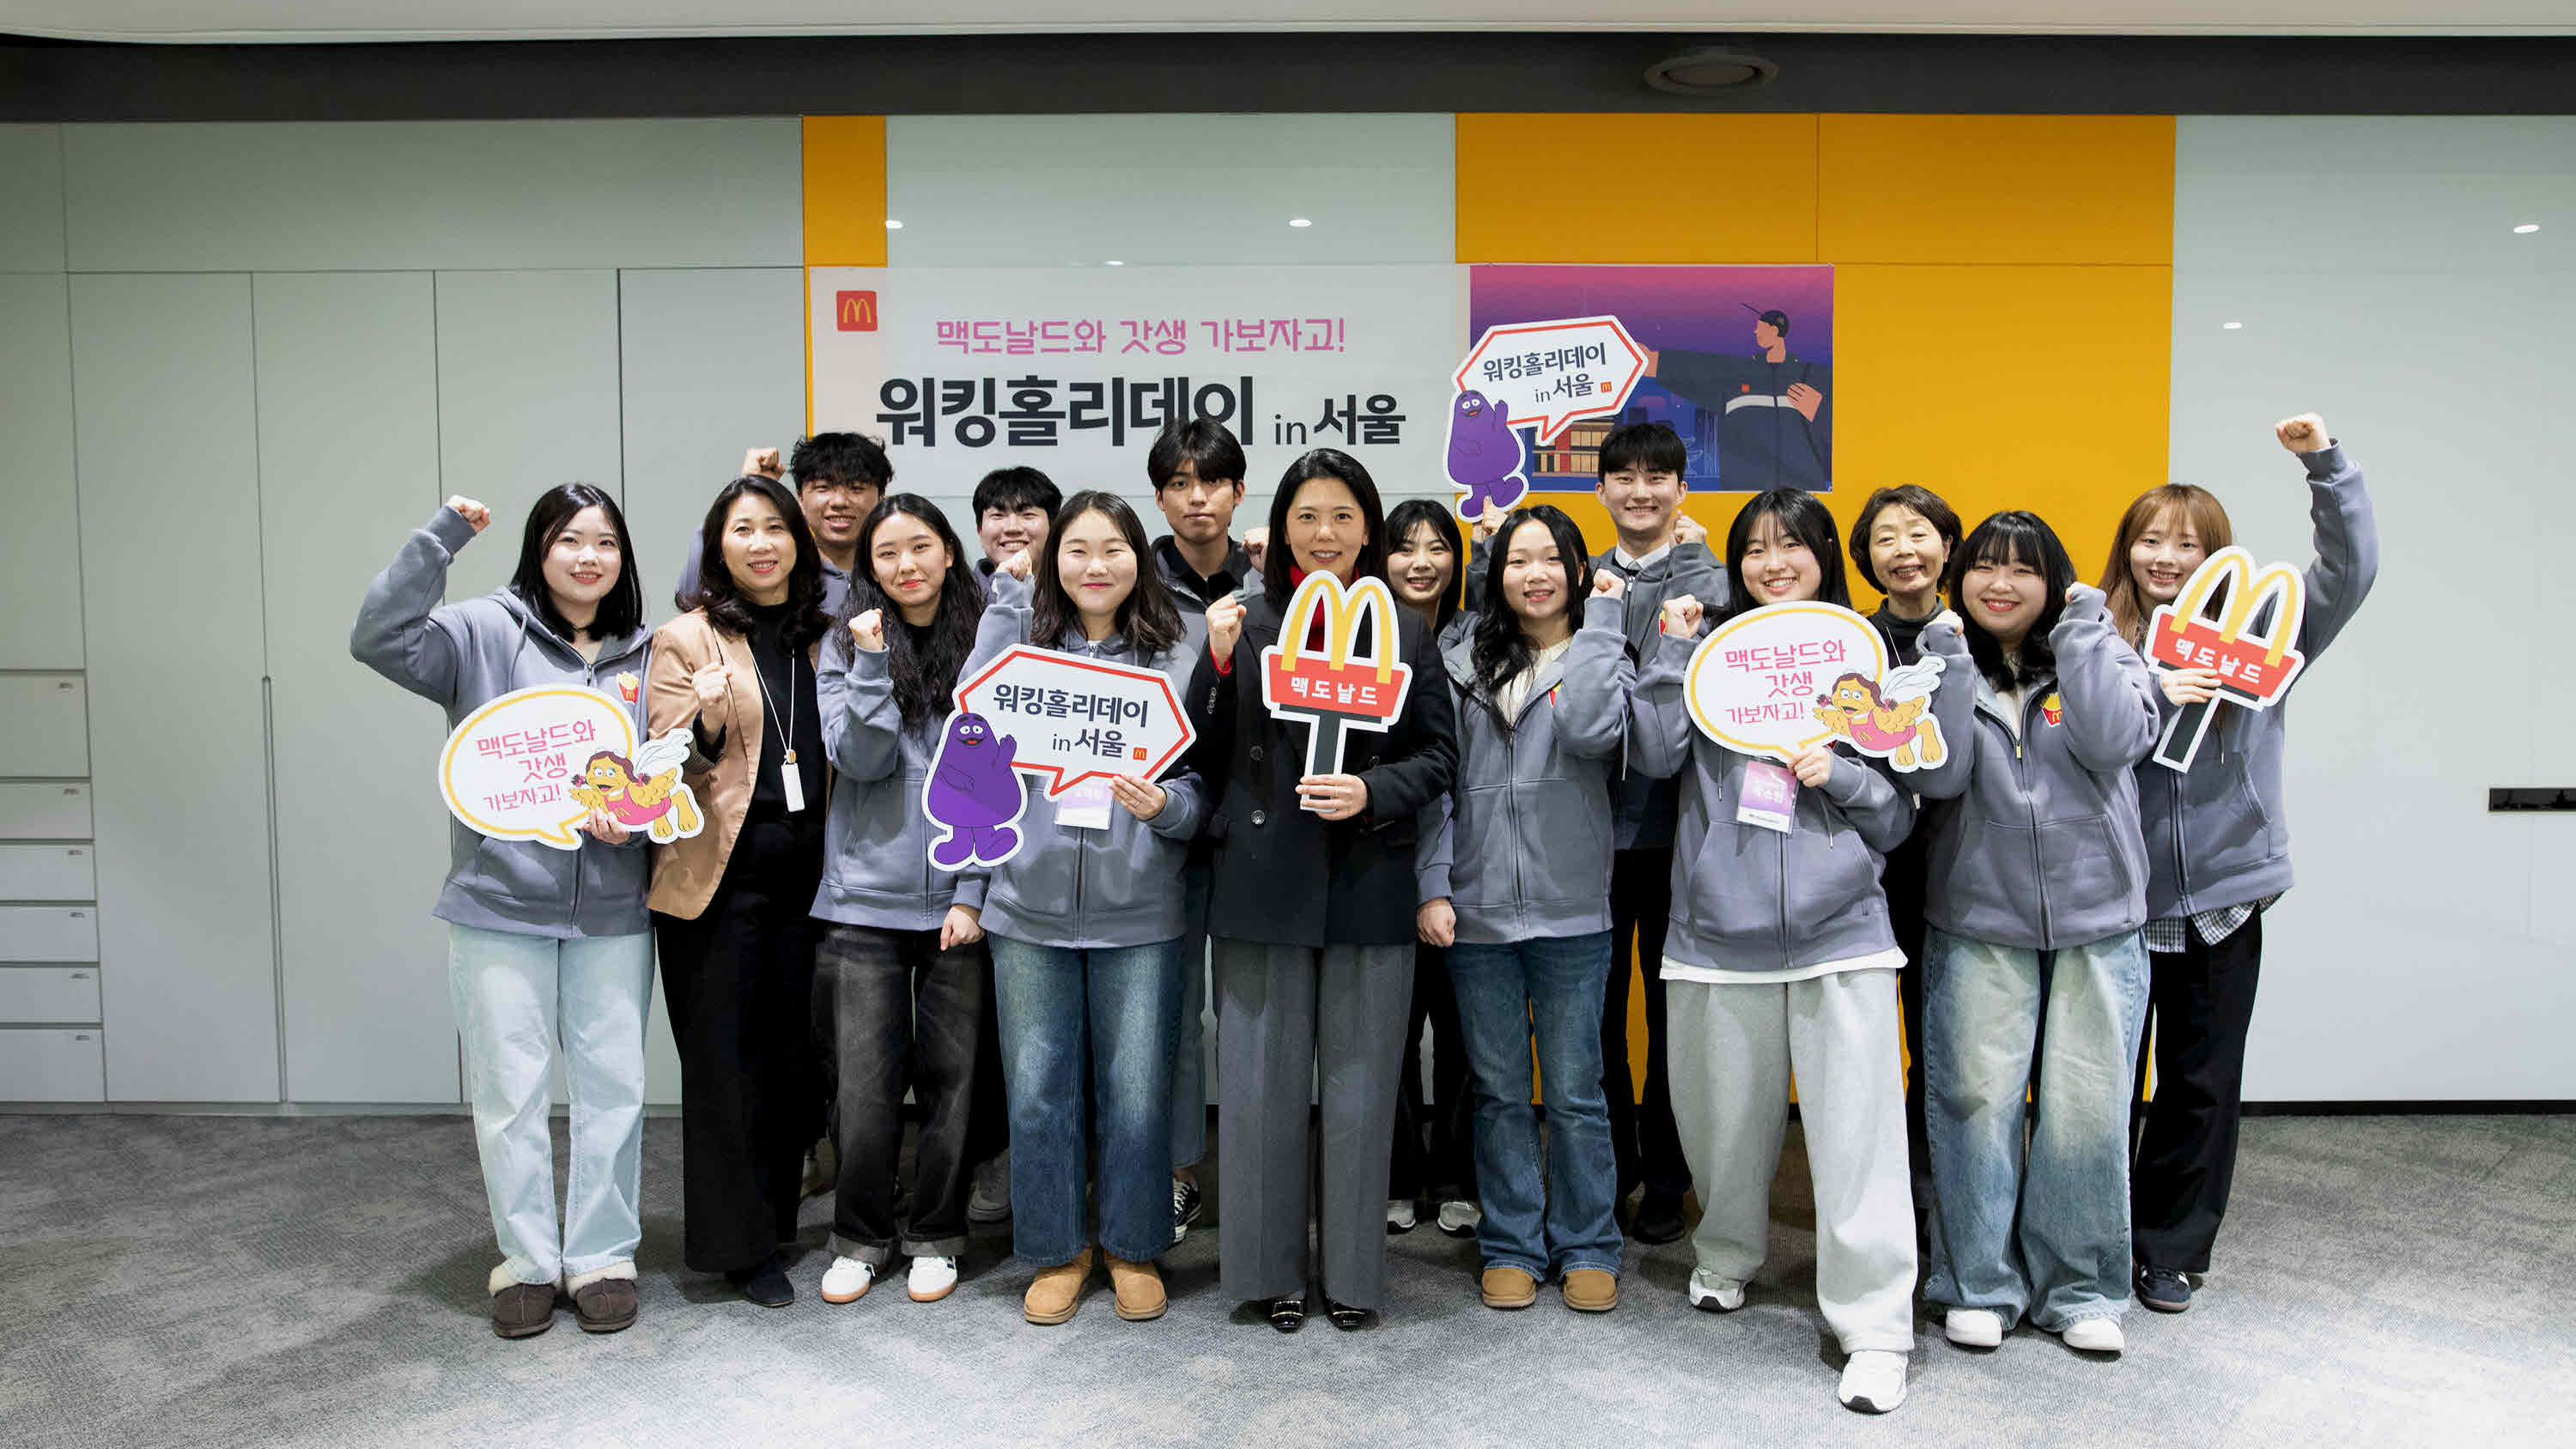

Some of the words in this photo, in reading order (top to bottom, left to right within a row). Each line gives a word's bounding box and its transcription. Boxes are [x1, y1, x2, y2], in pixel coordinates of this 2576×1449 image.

[936, 318, 1107, 355] 맥도날드와
[1120, 318, 1188, 355] 갓생
[1200, 318, 1346, 354] 가보자고!
[1483, 343, 1607, 382] 워킹홀리데이
[1534, 388, 1551, 404] in
[1552, 373, 1595, 398] 서울
[876, 375, 1253, 448] 워킹홀리데이
[1274, 414, 1307, 446] in
[1313, 394, 1407, 446] 서울
[1724, 640, 1847, 673] 맥도날드와
[2175, 637, 2263, 684] 맥도날드
[1291, 676, 1378, 705] 맥도날드
[1765, 670, 1814, 698] 갓생
[993, 683, 1149, 728] 워킹홀리데이
[1725, 702, 1804, 725] 가보자고!
[477, 719, 596, 759] 맥도날드와
[1053, 733, 1071, 752] in
[1075, 728, 1127, 759] 서울
[518, 754, 568, 784] 갓생
[482, 785, 562, 812] 가보자고!
